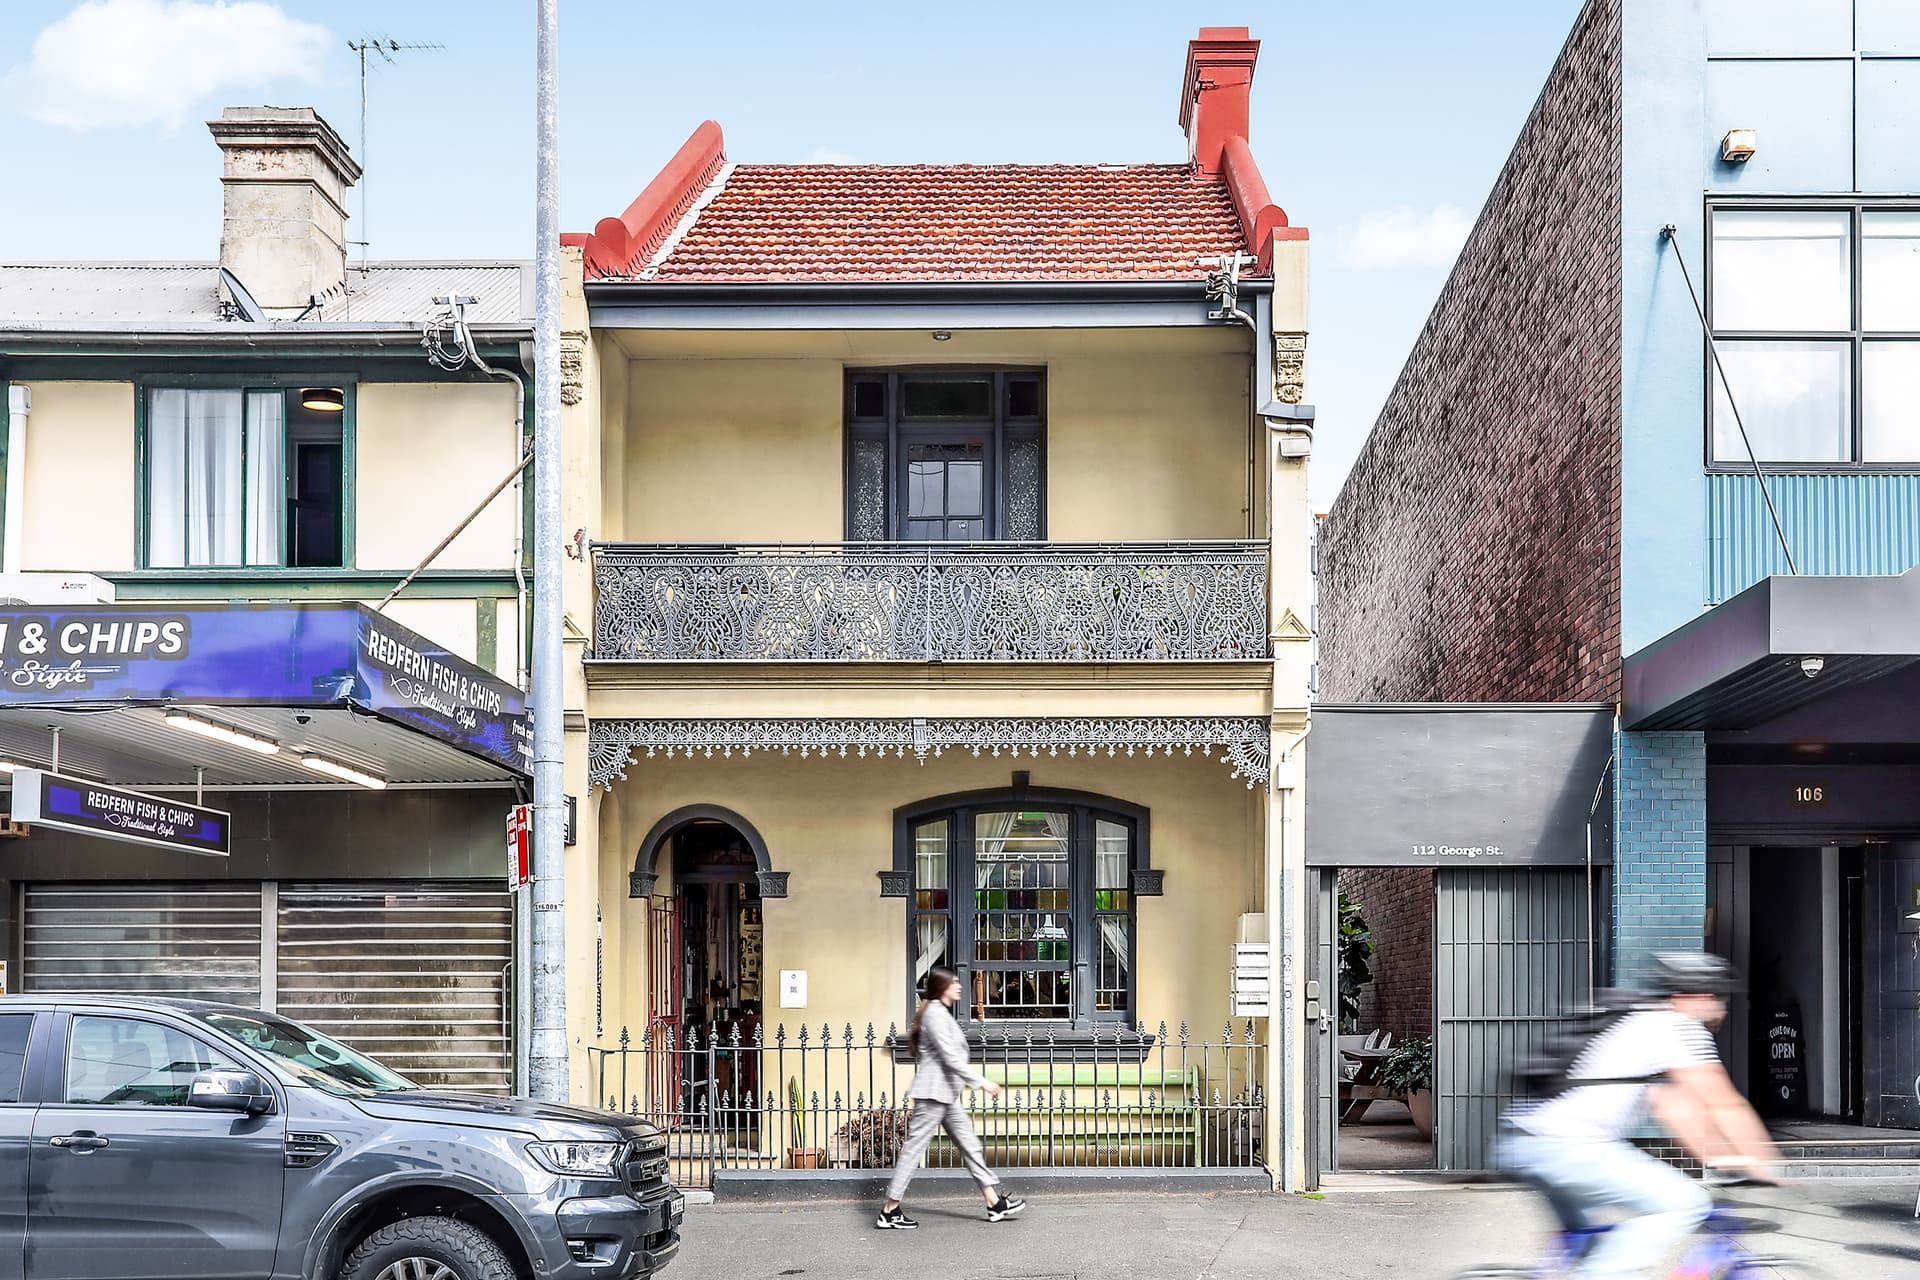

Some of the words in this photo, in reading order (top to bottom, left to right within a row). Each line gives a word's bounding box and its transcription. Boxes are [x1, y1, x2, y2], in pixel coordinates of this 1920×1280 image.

[18, 622, 48, 655] &
[59, 622, 186, 654] CHIPS
[368, 629, 431, 684] REDFERN
[431, 661, 459, 697] FISH
[460, 676, 468, 702] &
[470, 681, 501, 717] CHIPS
[412, 683, 456, 719] Traditional
[456, 704, 477, 730] Style
[87, 790, 135, 815] REDFERN
[136, 801, 158, 820] FISH
[159, 806, 167, 821] &
[167, 808, 195, 827] CHIPS
[1795, 787, 1823, 802] 106
[120, 815, 157, 832] Traditional
[157, 822, 175, 838] Style
[1412, 845, 1436, 856] 112
[1438, 845, 1483, 858] George
[1485, 845, 1505, 856] St.
[1771, 1042, 1796, 1060] OPEN
